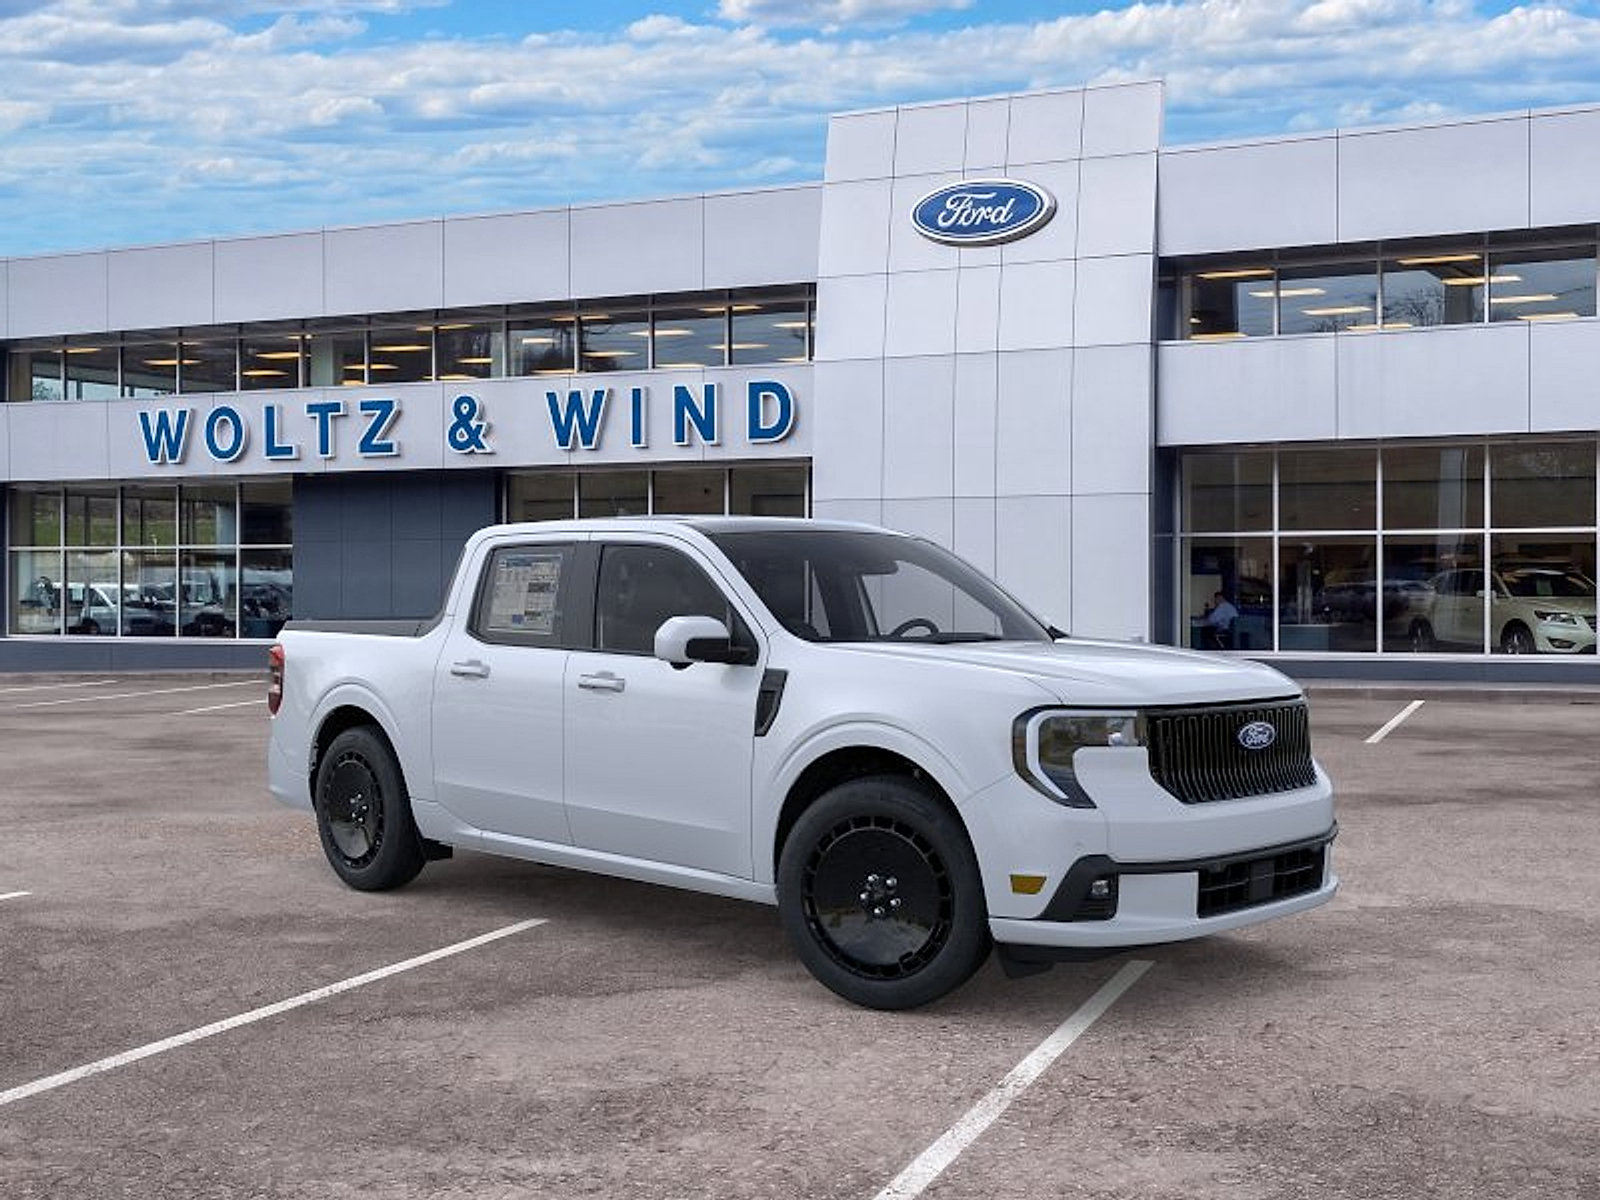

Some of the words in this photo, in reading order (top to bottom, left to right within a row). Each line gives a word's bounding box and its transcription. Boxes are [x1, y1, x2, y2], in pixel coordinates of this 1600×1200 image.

[938, 191, 1016, 228] Ford
[138, 398, 401, 464] WOLTZ
[447, 394, 491, 453] &
[545, 379, 796, 450] WIND
[1245, 726, 1270, 745] Ford
